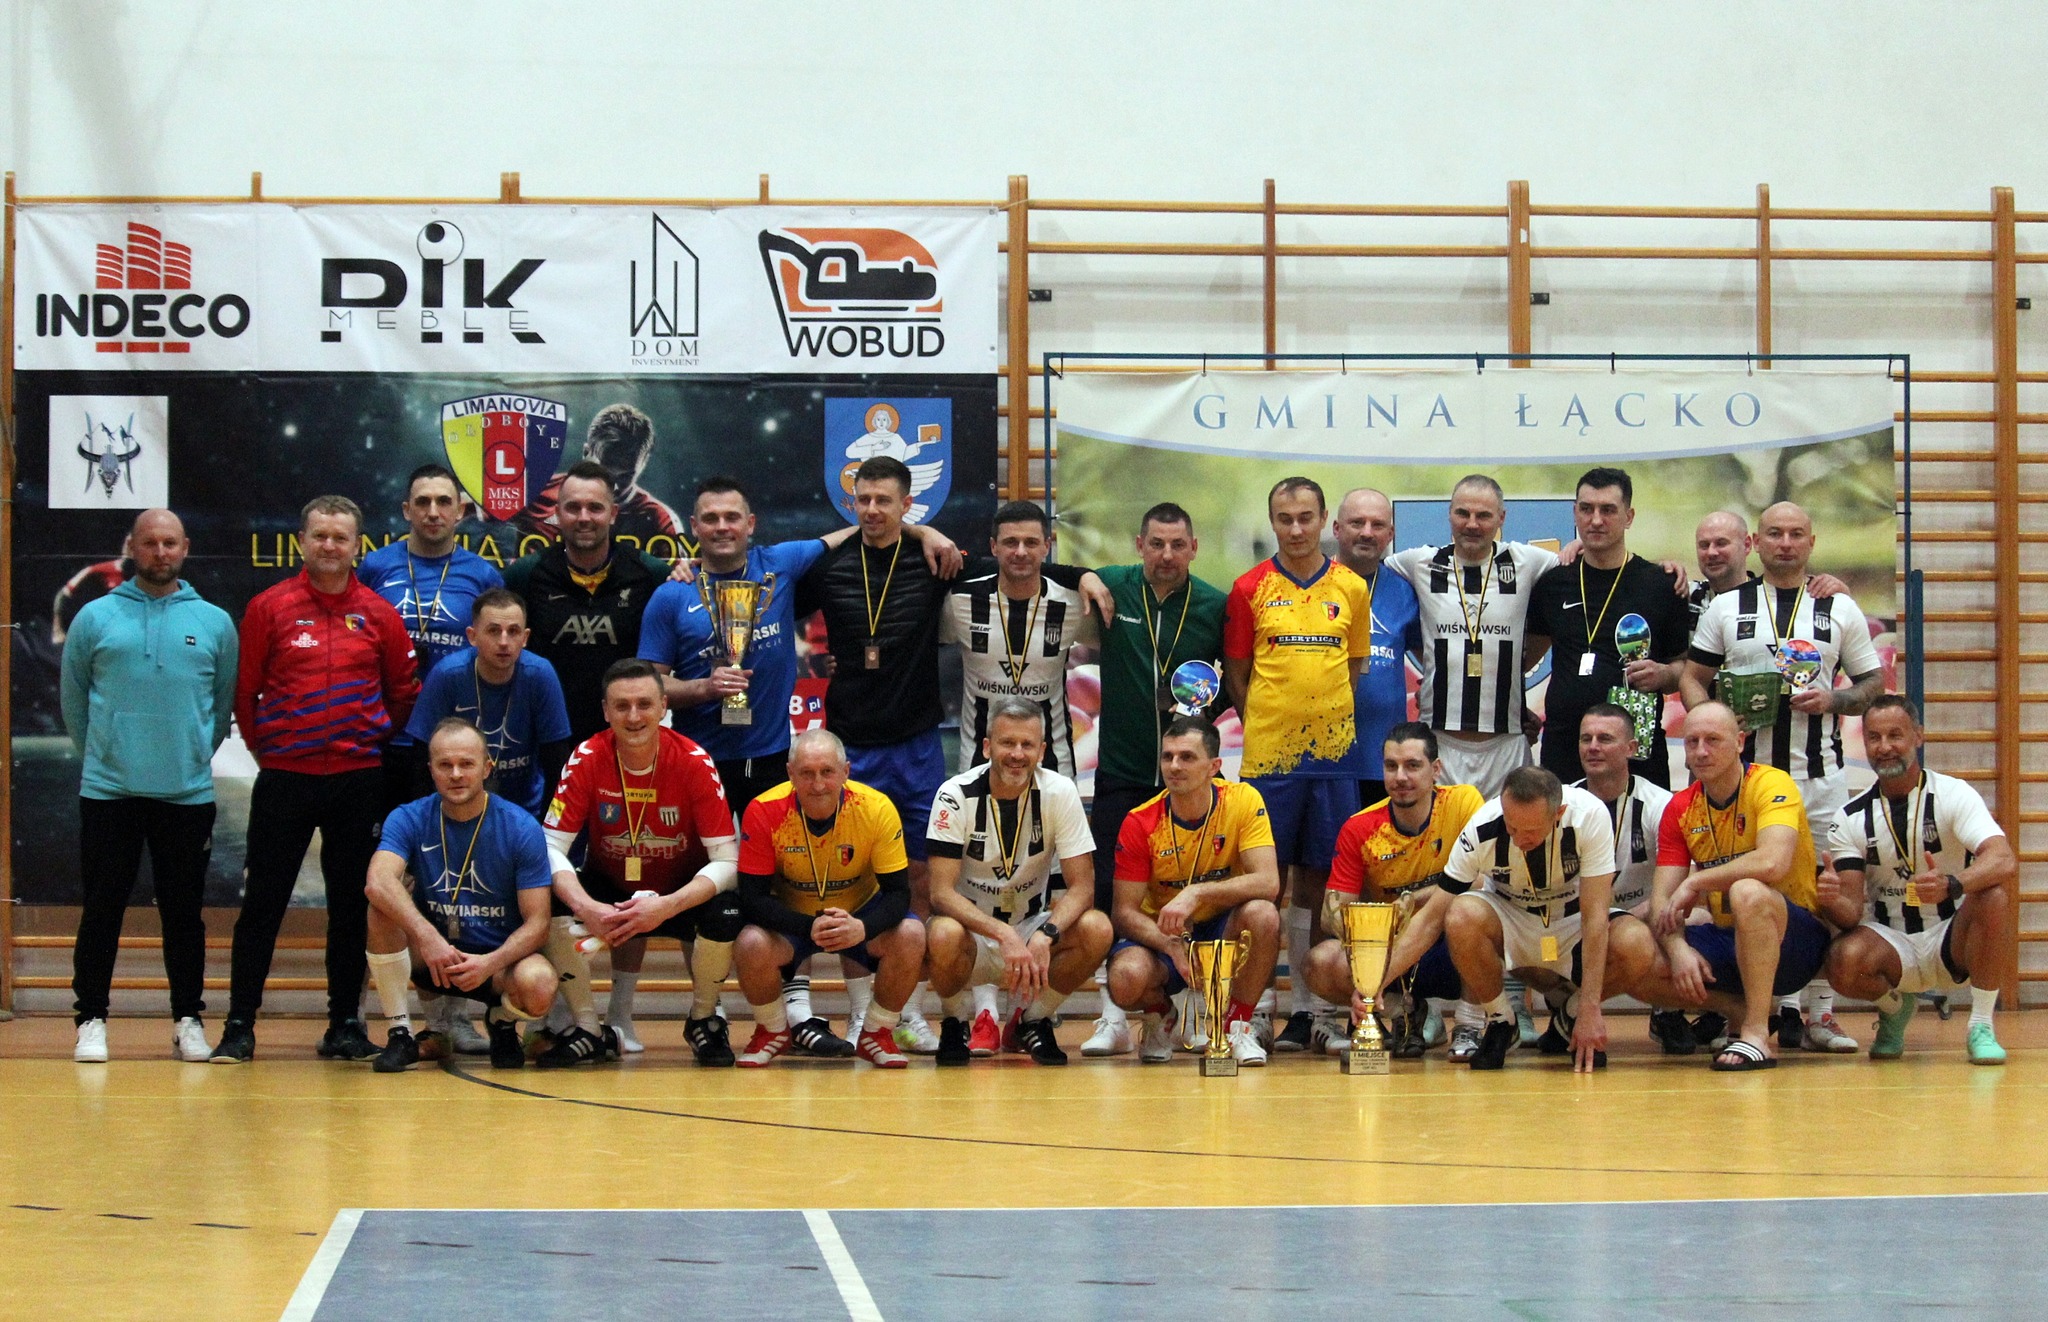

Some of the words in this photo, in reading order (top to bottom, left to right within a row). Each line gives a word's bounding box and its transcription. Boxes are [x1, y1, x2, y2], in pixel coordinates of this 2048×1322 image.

[36, 293, 250, 338] INDECO
[329, 309, 530, 331] MEBLE
[631, 339, 700, 357] DOM
[789, 325, 945, 358] WOBUD
[631, 358, 700, 366] INVESTMENT
[452, 397, 557, 419] LIMANOVIA
[1193, 393, 1458, 430] GMINA
[1514, 392, 1762, 437] ŁĄCKO
[496, 449, 516, 475] L
[489, 487, 520, 499] MKS
[490, 501, 520, 510] 1924
[551, 615, 618, 645] AXA
[1436, 622, 1511, 635] WIŚNOWSKI
[977, 681, 1049, 696] WIŚNIOWSKI
